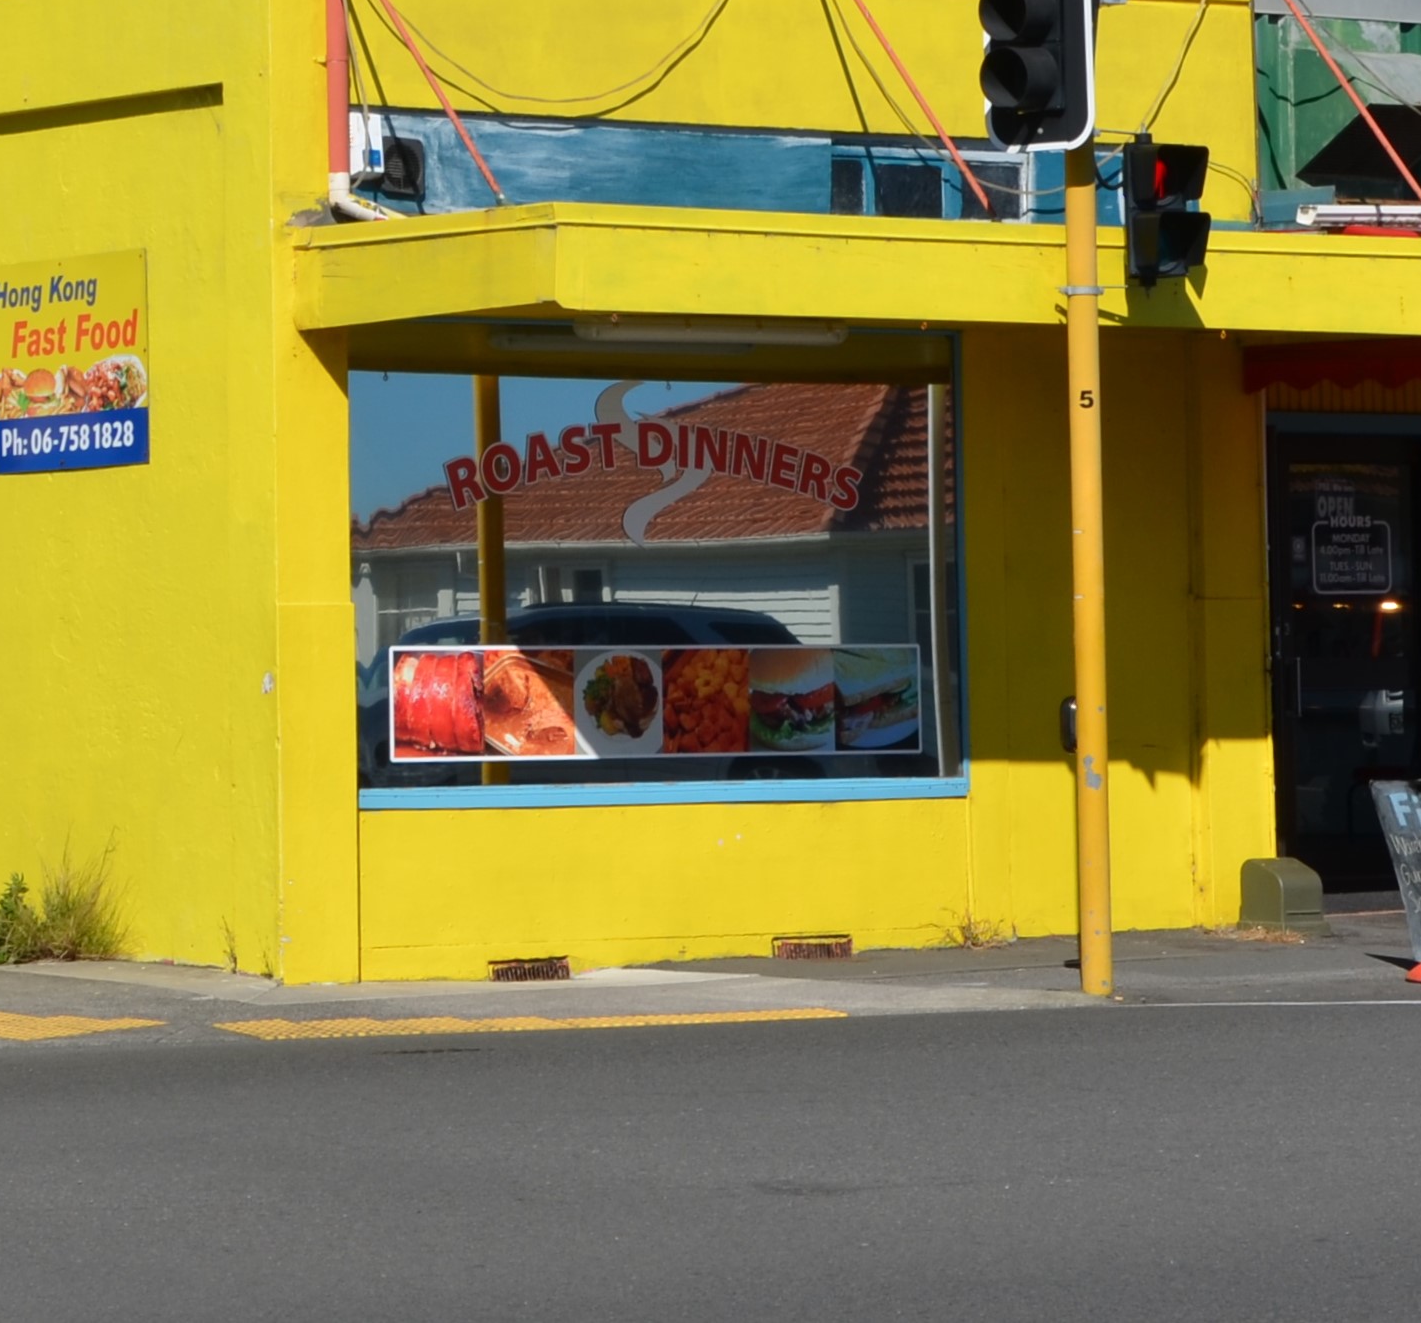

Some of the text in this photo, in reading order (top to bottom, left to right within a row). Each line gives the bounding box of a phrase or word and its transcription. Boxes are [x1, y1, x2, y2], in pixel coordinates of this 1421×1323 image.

[49, 275, 98, 307] Kong
[11, 308, 139, 359] Fast Food
[1079, 389, 1094, 409] 5
[1, 420, 135, 457] Ph: 06-758 1828
[443, 420, 864, 512] ROAST DINNERS
[1317, 495, 1354, 518] OPEN
[1330, 515, 1372, 528] HOURS
[1331, 533, 1371, 543] MONDAY
